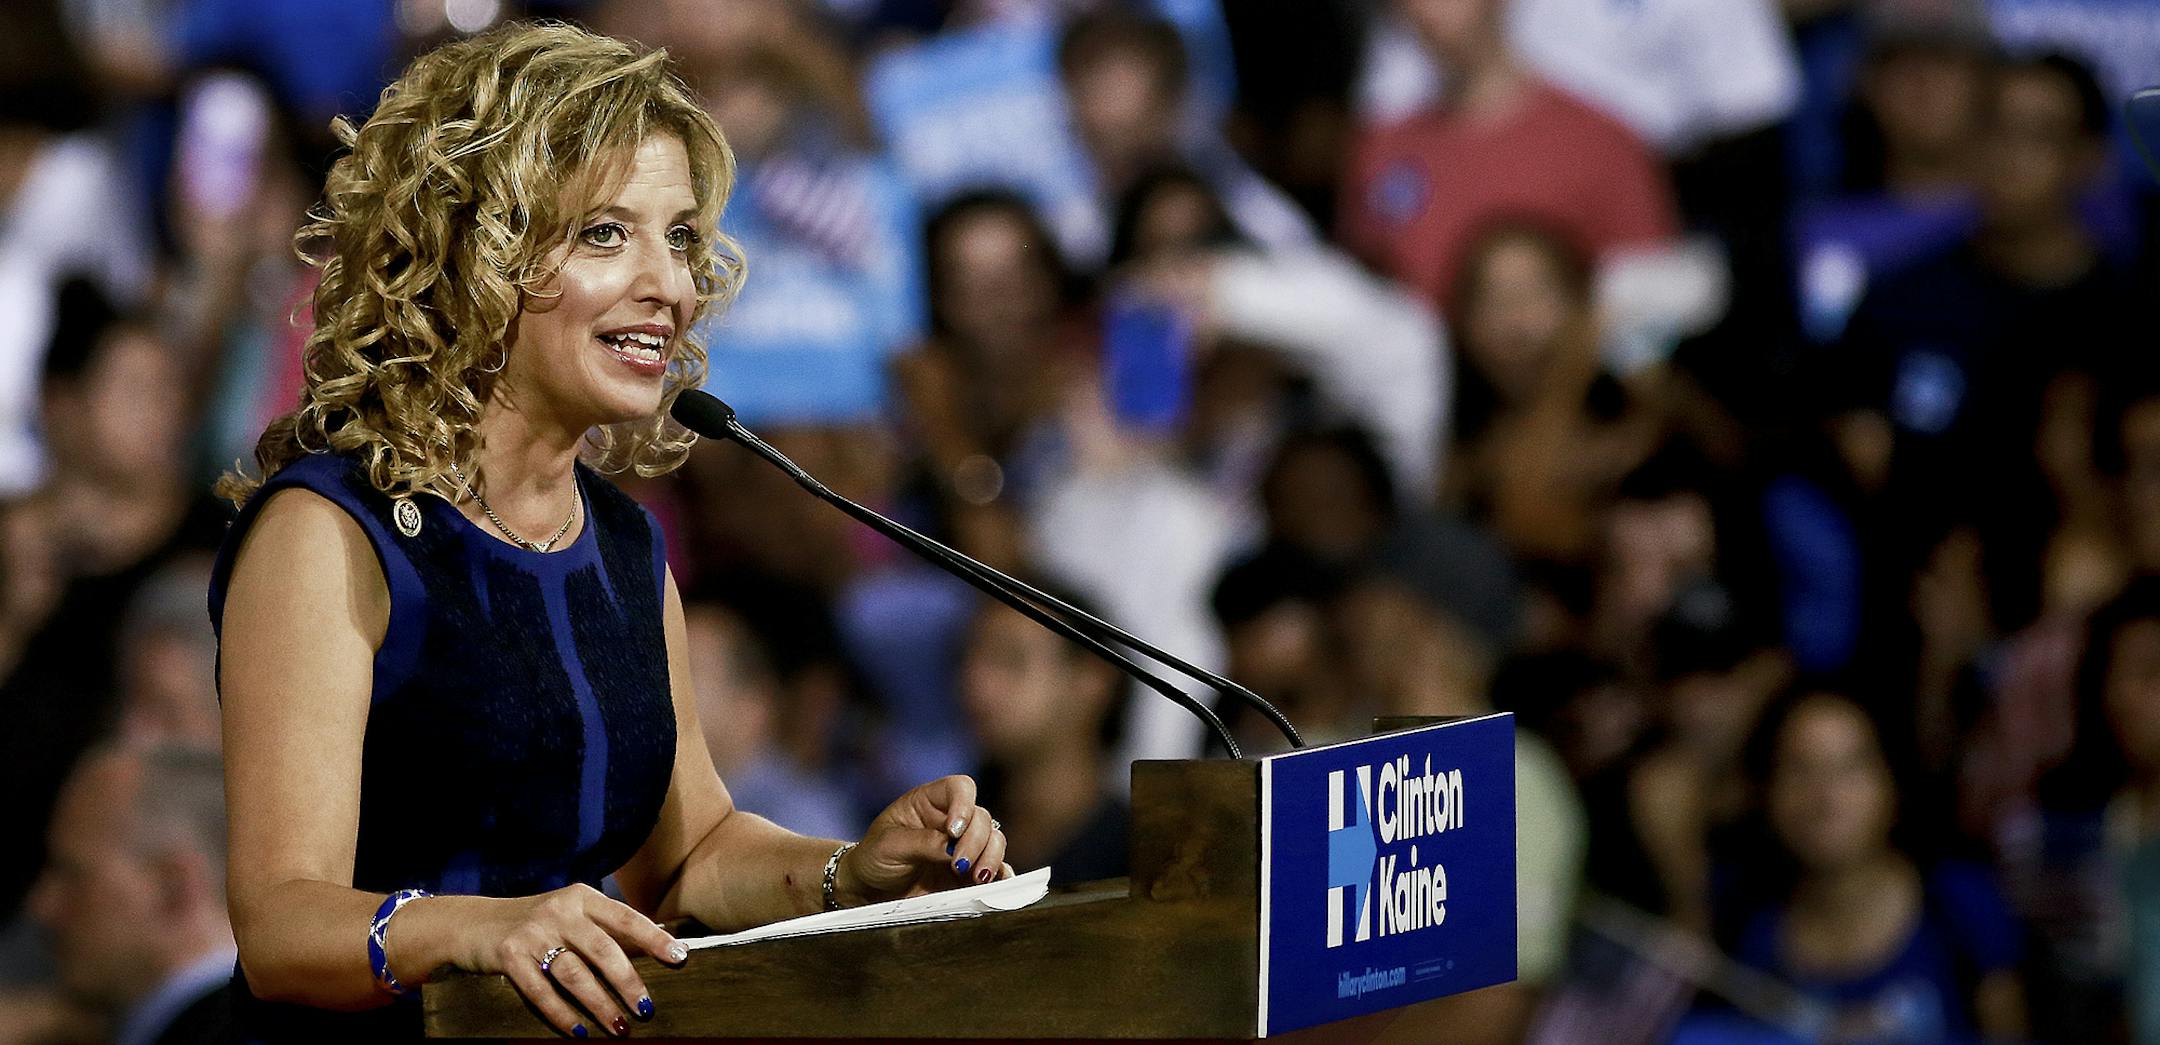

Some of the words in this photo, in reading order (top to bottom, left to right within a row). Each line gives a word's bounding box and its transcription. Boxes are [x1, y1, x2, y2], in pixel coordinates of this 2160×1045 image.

[1378, 753, 1464, 844] Clinton
[1379, 845, 1447, 937] Kaine
[1338, 967, 1406, 1000] hillaryclinton.com
